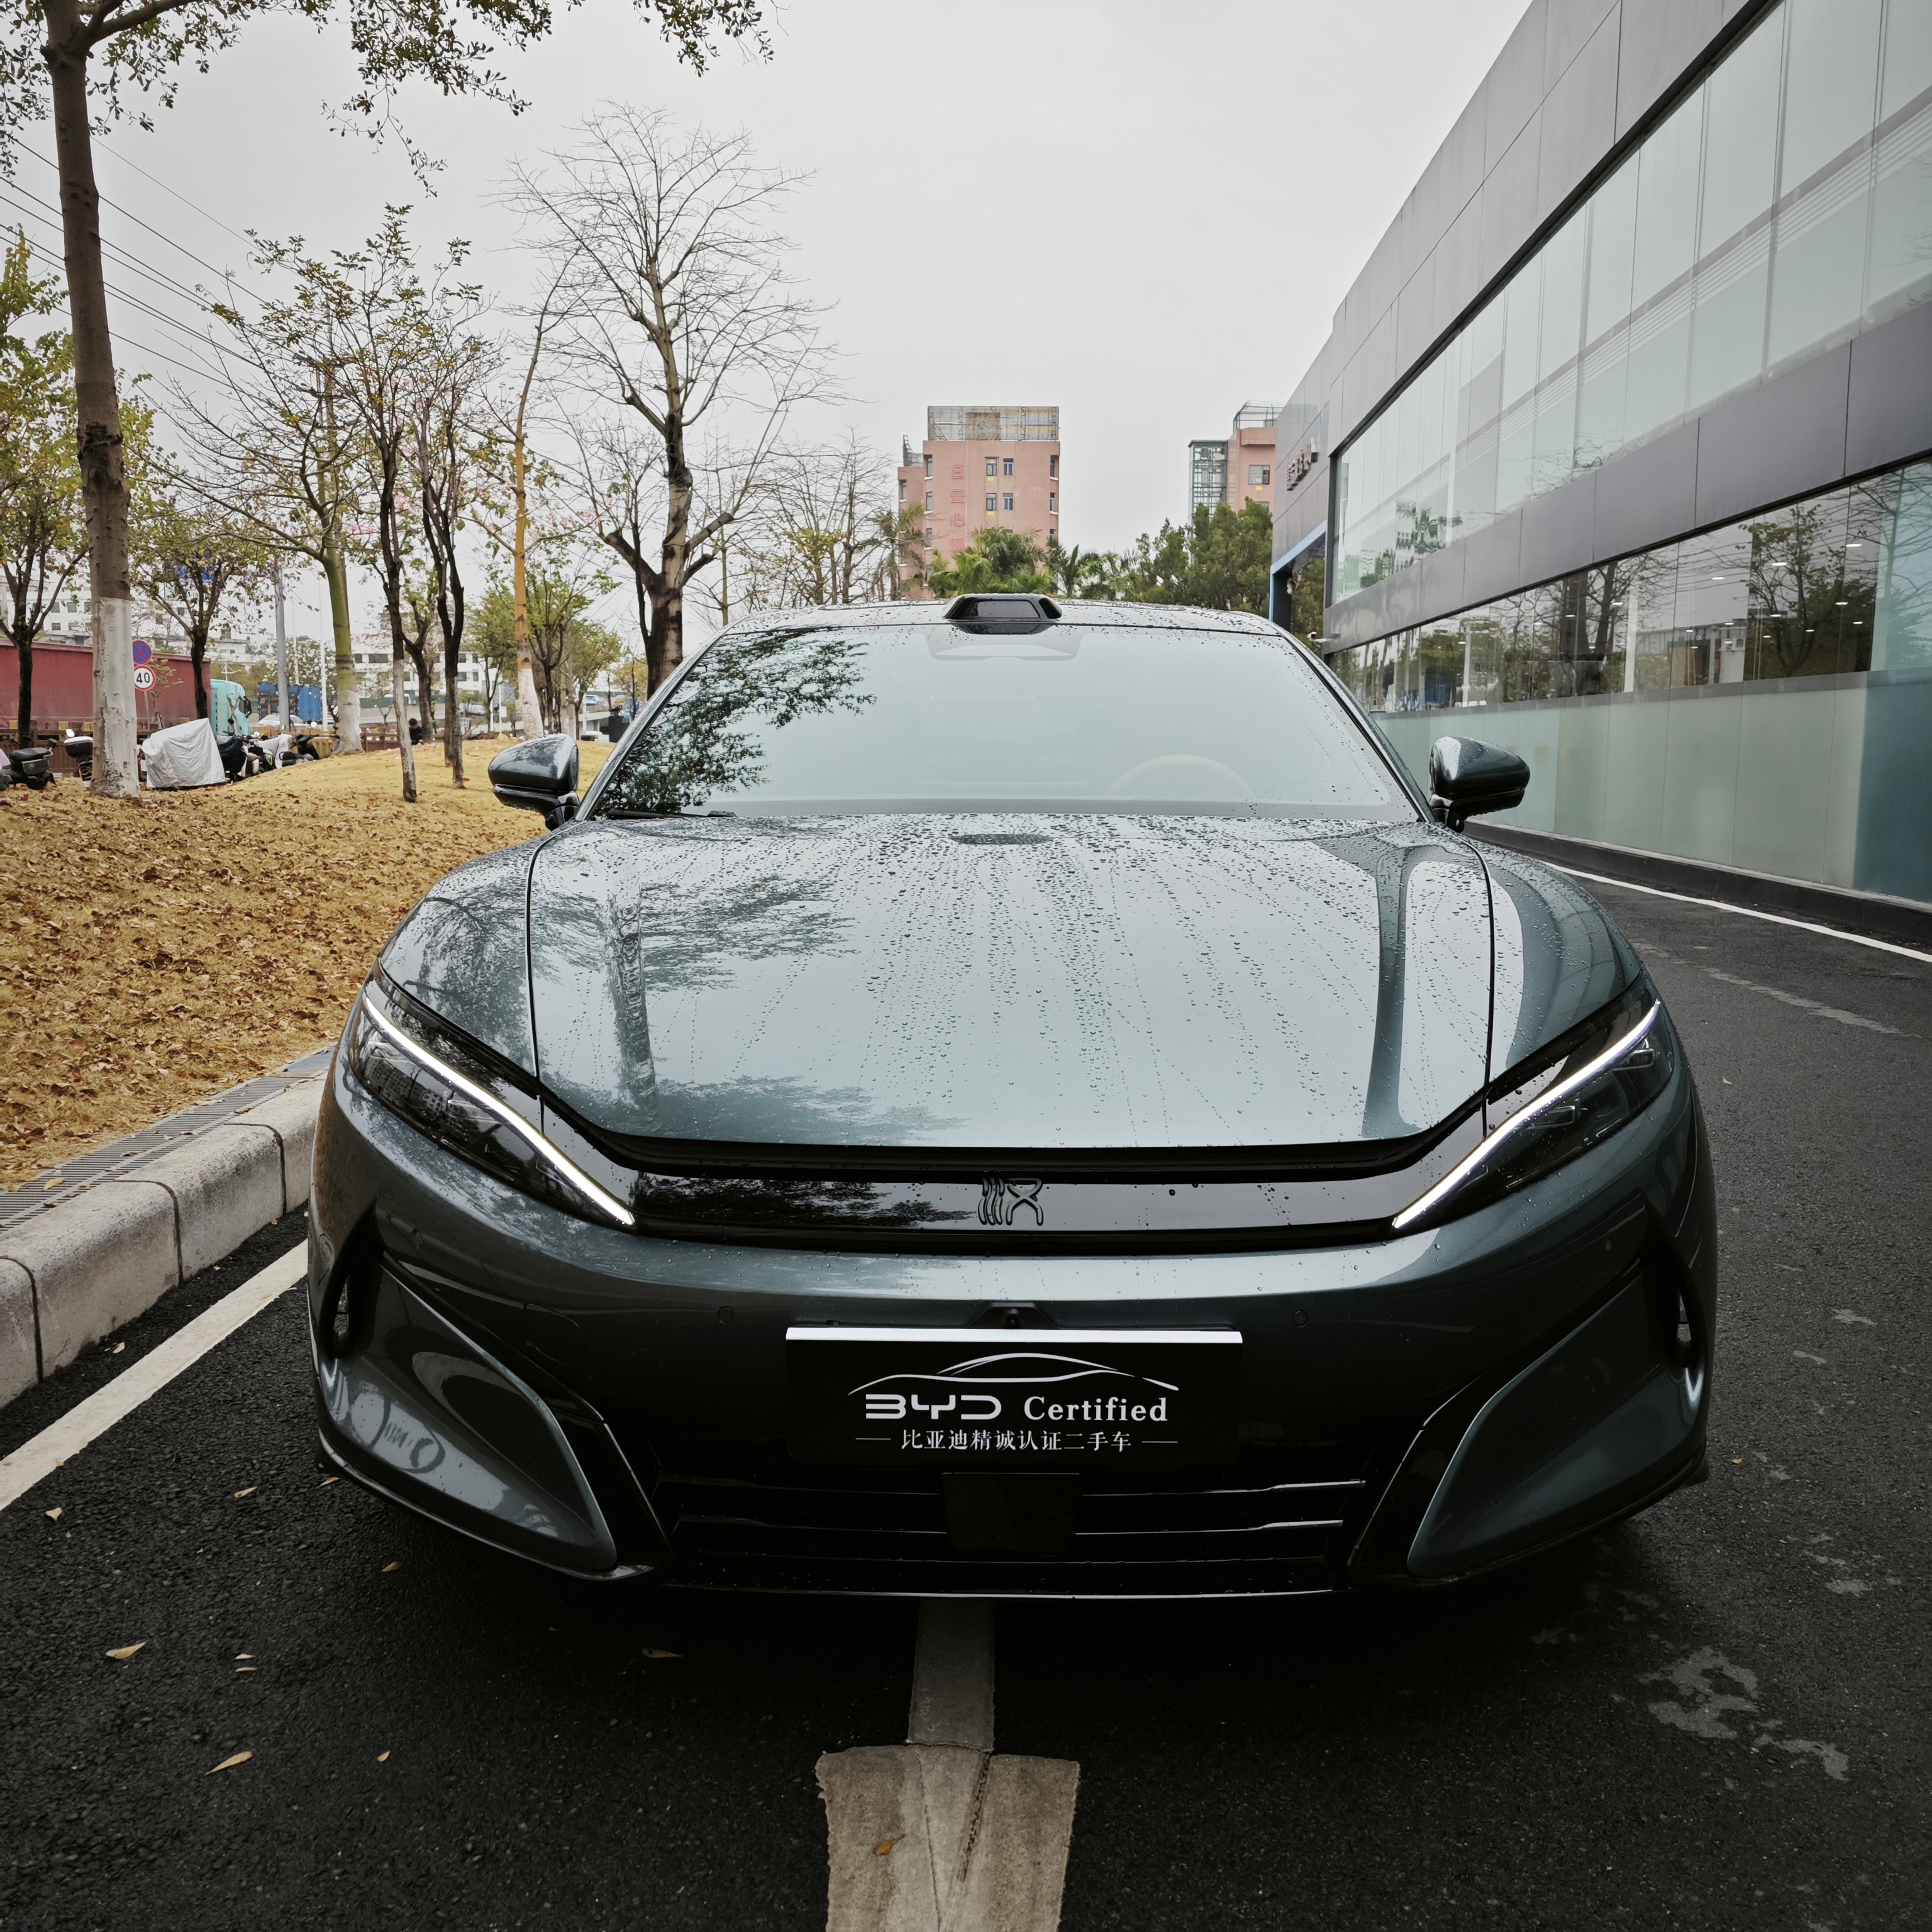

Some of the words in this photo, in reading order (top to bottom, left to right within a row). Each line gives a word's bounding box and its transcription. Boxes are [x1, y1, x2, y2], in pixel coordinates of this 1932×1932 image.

[136, 672, 150, 684] 40
[865, 1394, 1002, 1420] BYD
[1024, 1396, 1168, 1421] Certified
[901, 1429, 1131, 1452] 比亚迪精诚认证二手车
